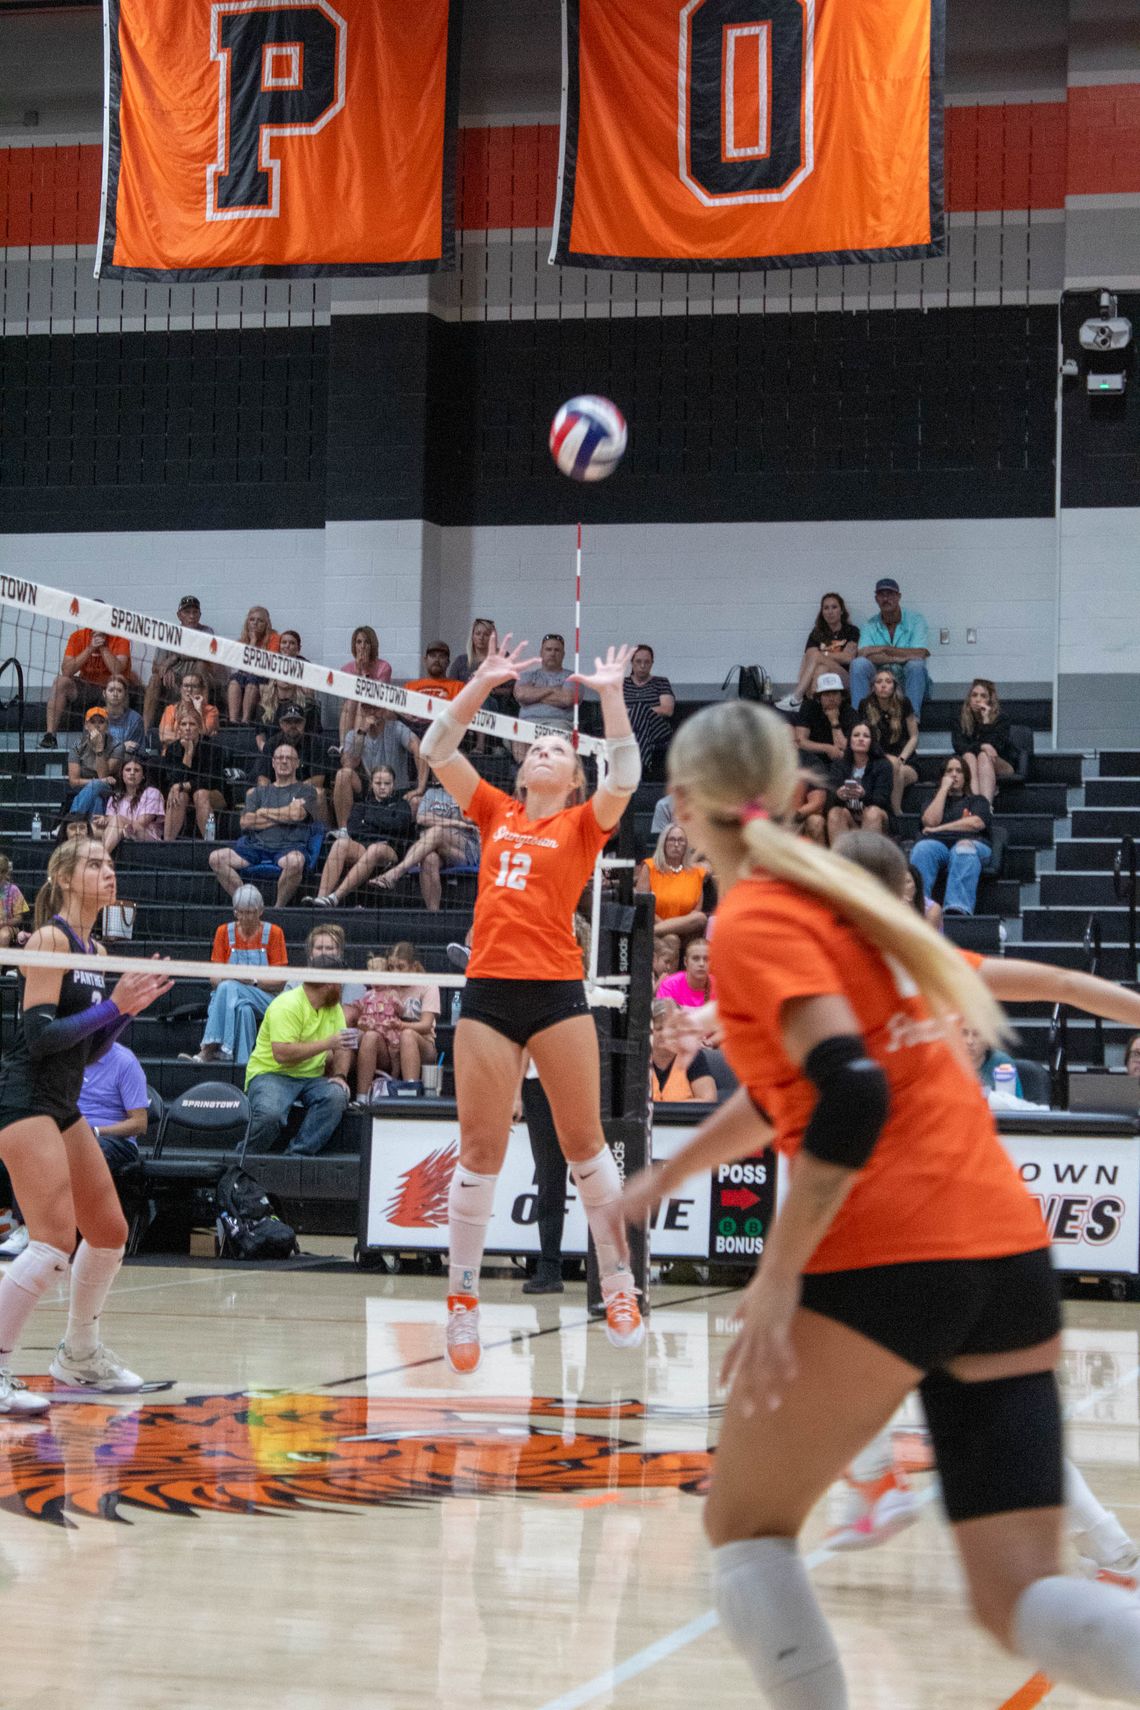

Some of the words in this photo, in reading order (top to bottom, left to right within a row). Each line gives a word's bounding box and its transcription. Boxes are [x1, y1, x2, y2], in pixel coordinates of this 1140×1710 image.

[206, 0, 348, 222] P
[110, 607, 184, 647] SPRINGTOWN
[242, 646, 305, 680] SPRINGTOWN
[355, 677, 408, 708] SPRINGTOWN
[495, 850, 532, 891] 12
[618, 937, 629, 972] sports
[181, 1099, 241, 1109] SPRINGTOWN
[718, 1164, 767, 1184] POSS
[716, 1237, 764, 1254] BONUS
